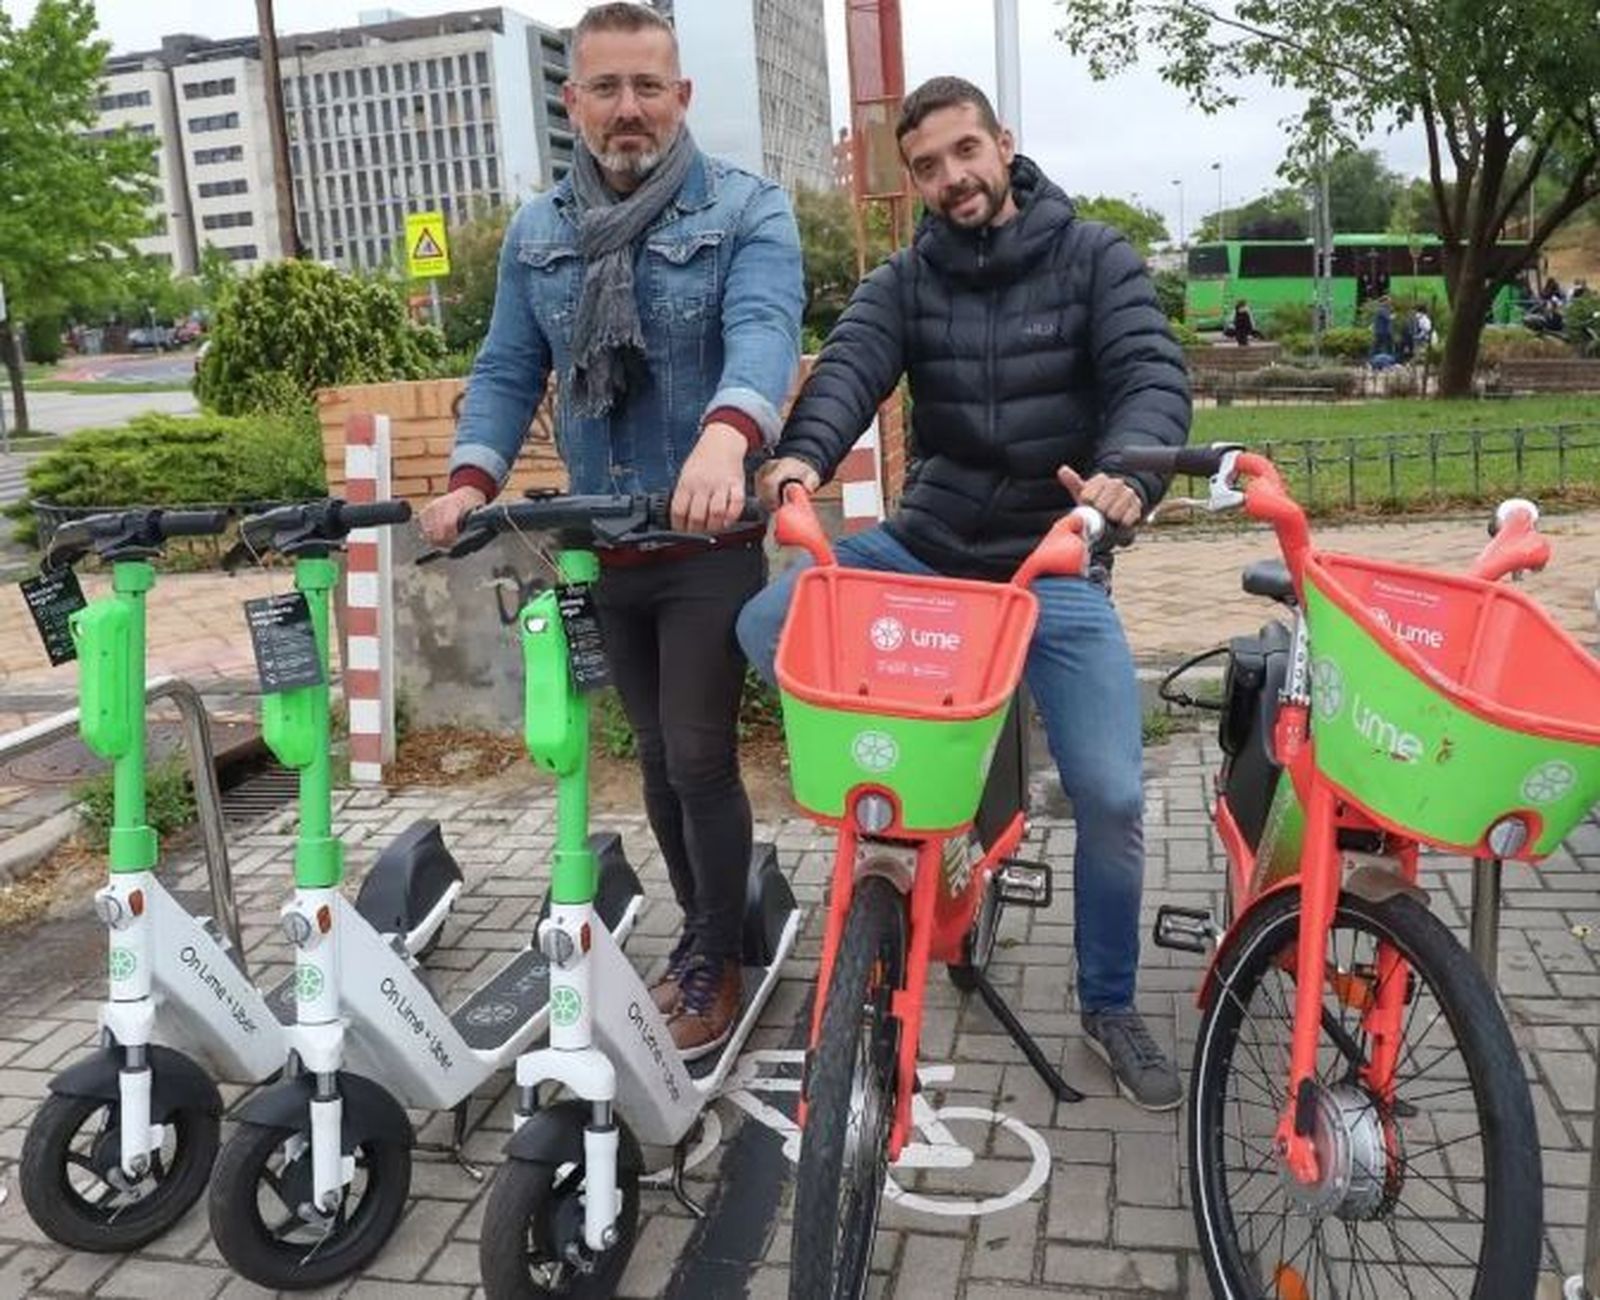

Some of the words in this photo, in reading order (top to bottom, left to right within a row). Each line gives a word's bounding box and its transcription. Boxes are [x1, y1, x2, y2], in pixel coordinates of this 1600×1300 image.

[180, 946, 201, 971] On
[199, 964, 227, 1000] Lime
[380, 977, 399, 1006] On
[397, 996, 425, 1035] Lime
[628, 1001, 644, 1031] On
